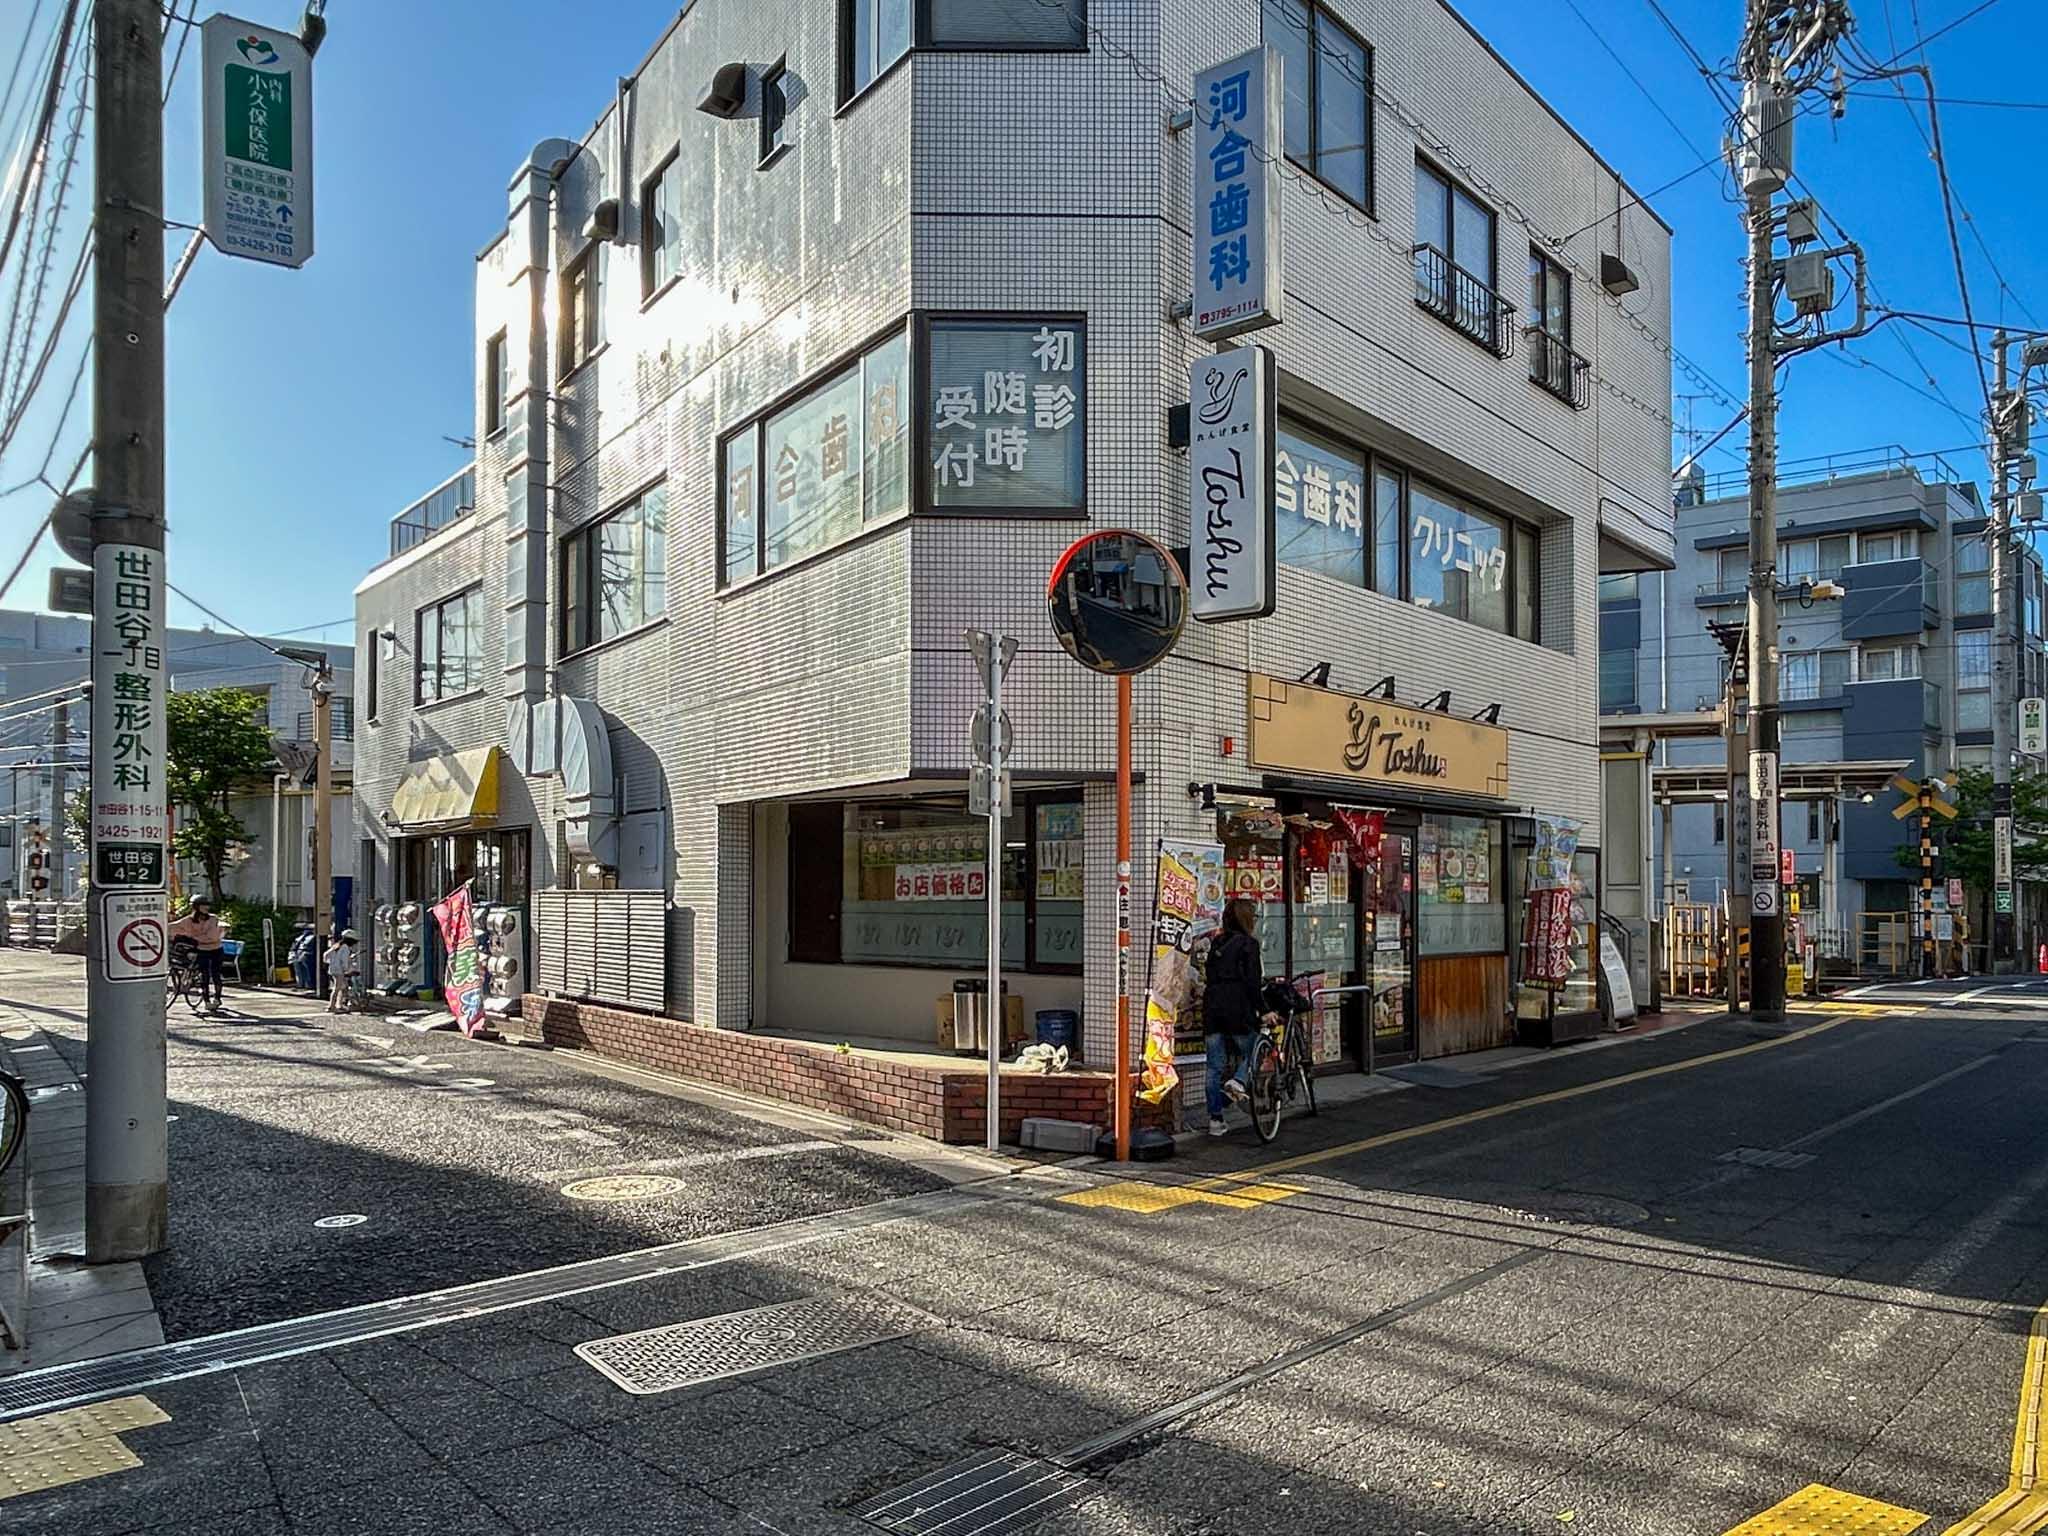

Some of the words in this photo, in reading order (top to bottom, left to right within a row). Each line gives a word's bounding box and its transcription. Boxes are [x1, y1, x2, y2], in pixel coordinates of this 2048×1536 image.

[247, 72, 270, 163] 小久保医院
[227, 191, 271, 210] この先
[1209, 70, 1250, 291] 河合歯科
[1210, 298, 1259, 322] 3795-1114
[983, 370, 1029, 472] 随時
[1031, 326, 1076, 431] 初診
[933, 385, 979, 488] 受付
[1202, 447, 1246, 598] Toshu
[1377, 731, 1442, 776] Toshu
[108, 851, 154, 865] 世田谷
[114, 867, 150, 881] 4-2
